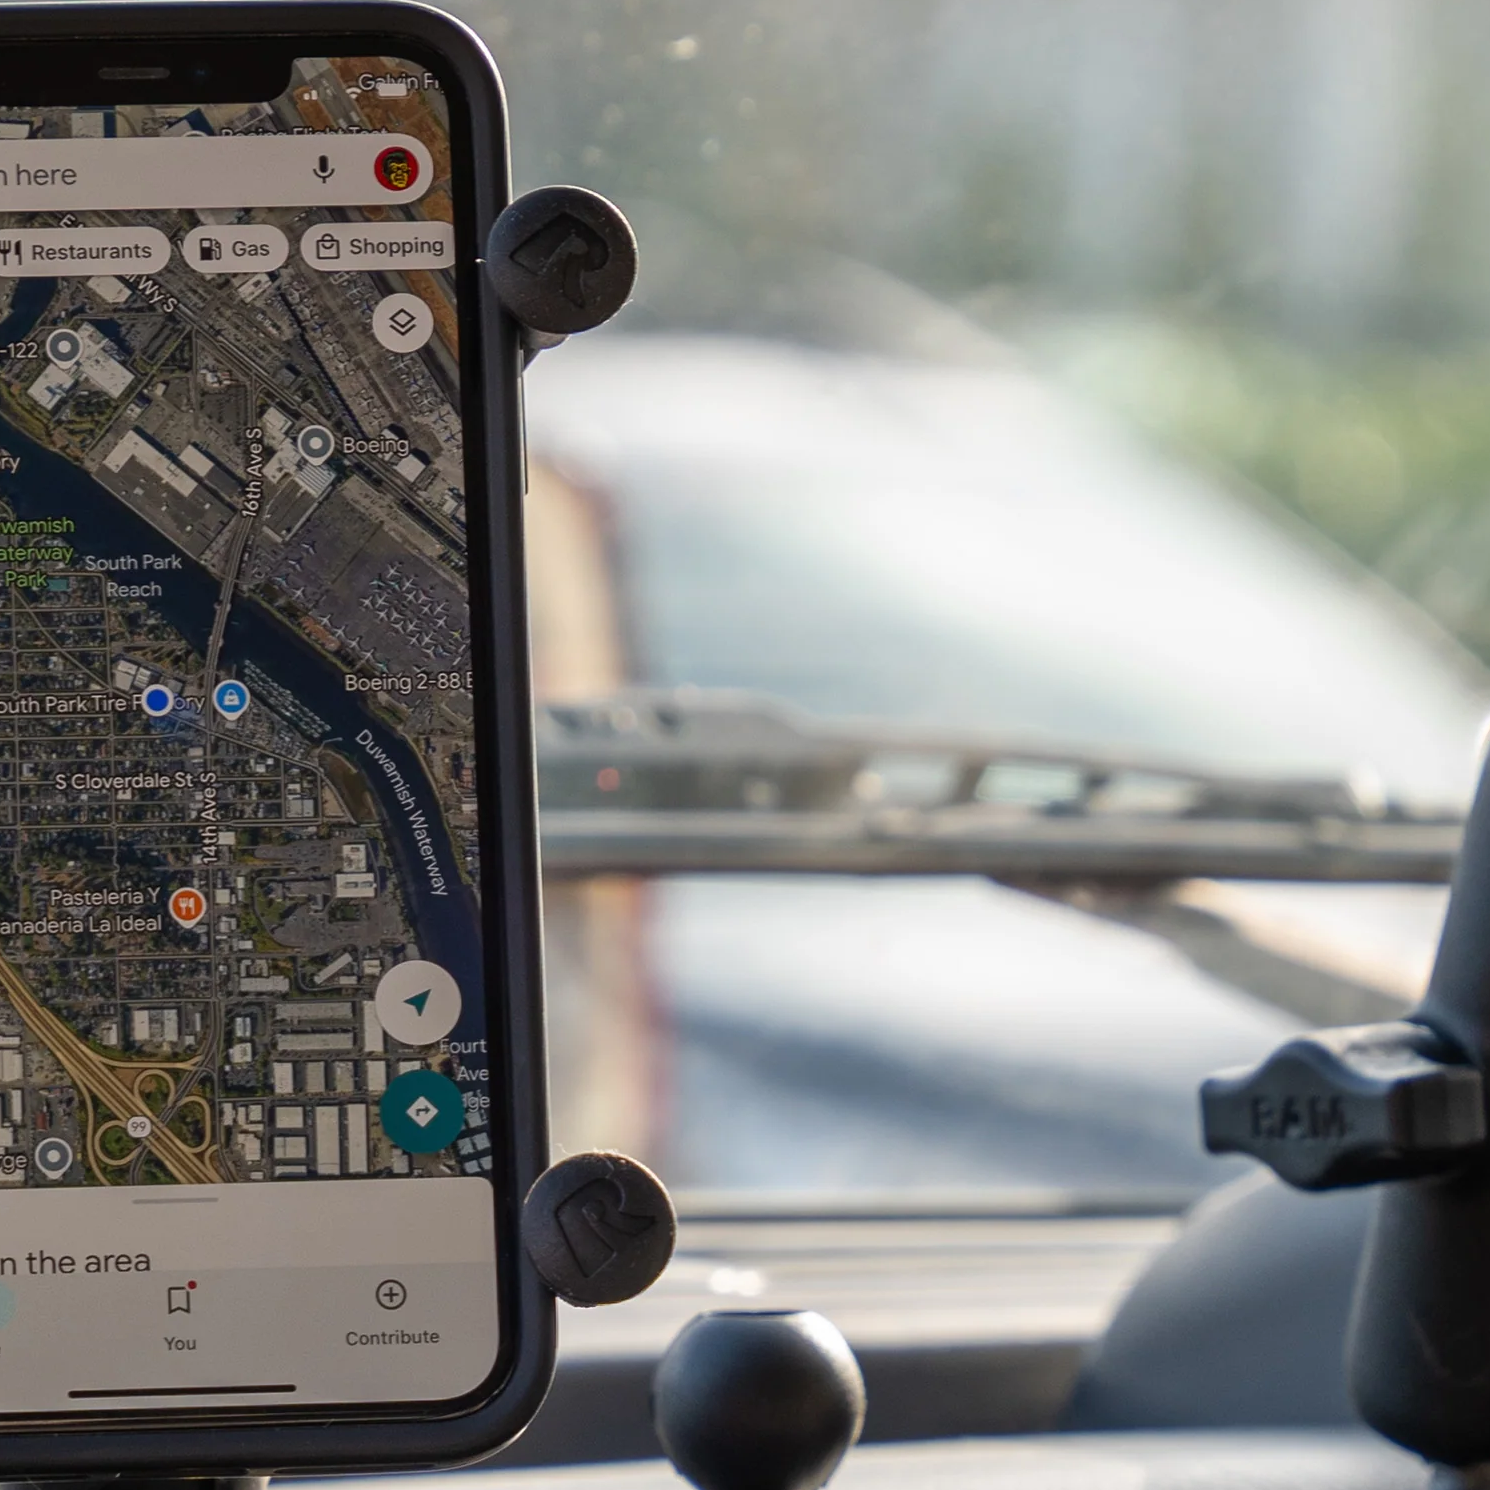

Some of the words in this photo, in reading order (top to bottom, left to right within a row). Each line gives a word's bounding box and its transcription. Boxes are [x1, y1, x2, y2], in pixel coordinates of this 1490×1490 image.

[16, 162, 77, 186] here
[32, 242, 152, 261] Restaurants
[232, 240, 270, 257] Gas
[350, 237, 444, 257] Shopping
[246, 428, 262, 439] S
[343, 437, 409, 458] Boeing
[246, 443, 262, 476] Ave
[242, 480, 262, 517] 16th
[85, 555, 138, 571] South
[143, 553, 182, 569] Park
[5, 570, 47, 588] Park
[108, 581, 162, 597] Reach
[345, 674, 412, 694] Boeing
[417, 672, 461, 689] 2-88
[45, 696, 87, 712] Park
[91, 696, 126, 711] Tire
[131, 694, 205, 713] Fory
[55, 774, 65, 789] S
[71, 772, 170, 789] Cloverdale
[175, 772, 193, 787] St
[201, 787, 216, 821] Ave
[355, 728, 415, 811] Duwamish
[409, 810, 448, 896] Waterway
[201, 825, 217, 864] 14th
[50, 889, 142, 907] Pasteleria
[148, 887, 161, 903] Y
[89, 916, 111, 932] La
[116, 914, 162, 931] Ideal
[131, 1121, 146, 1132] 99
[26, 1249, 76, 1275] the
[85, 1252, 151, 1274] area
[164, 1336, 197, 1351] You
[345, 1329, 440, 1347] Contribute
